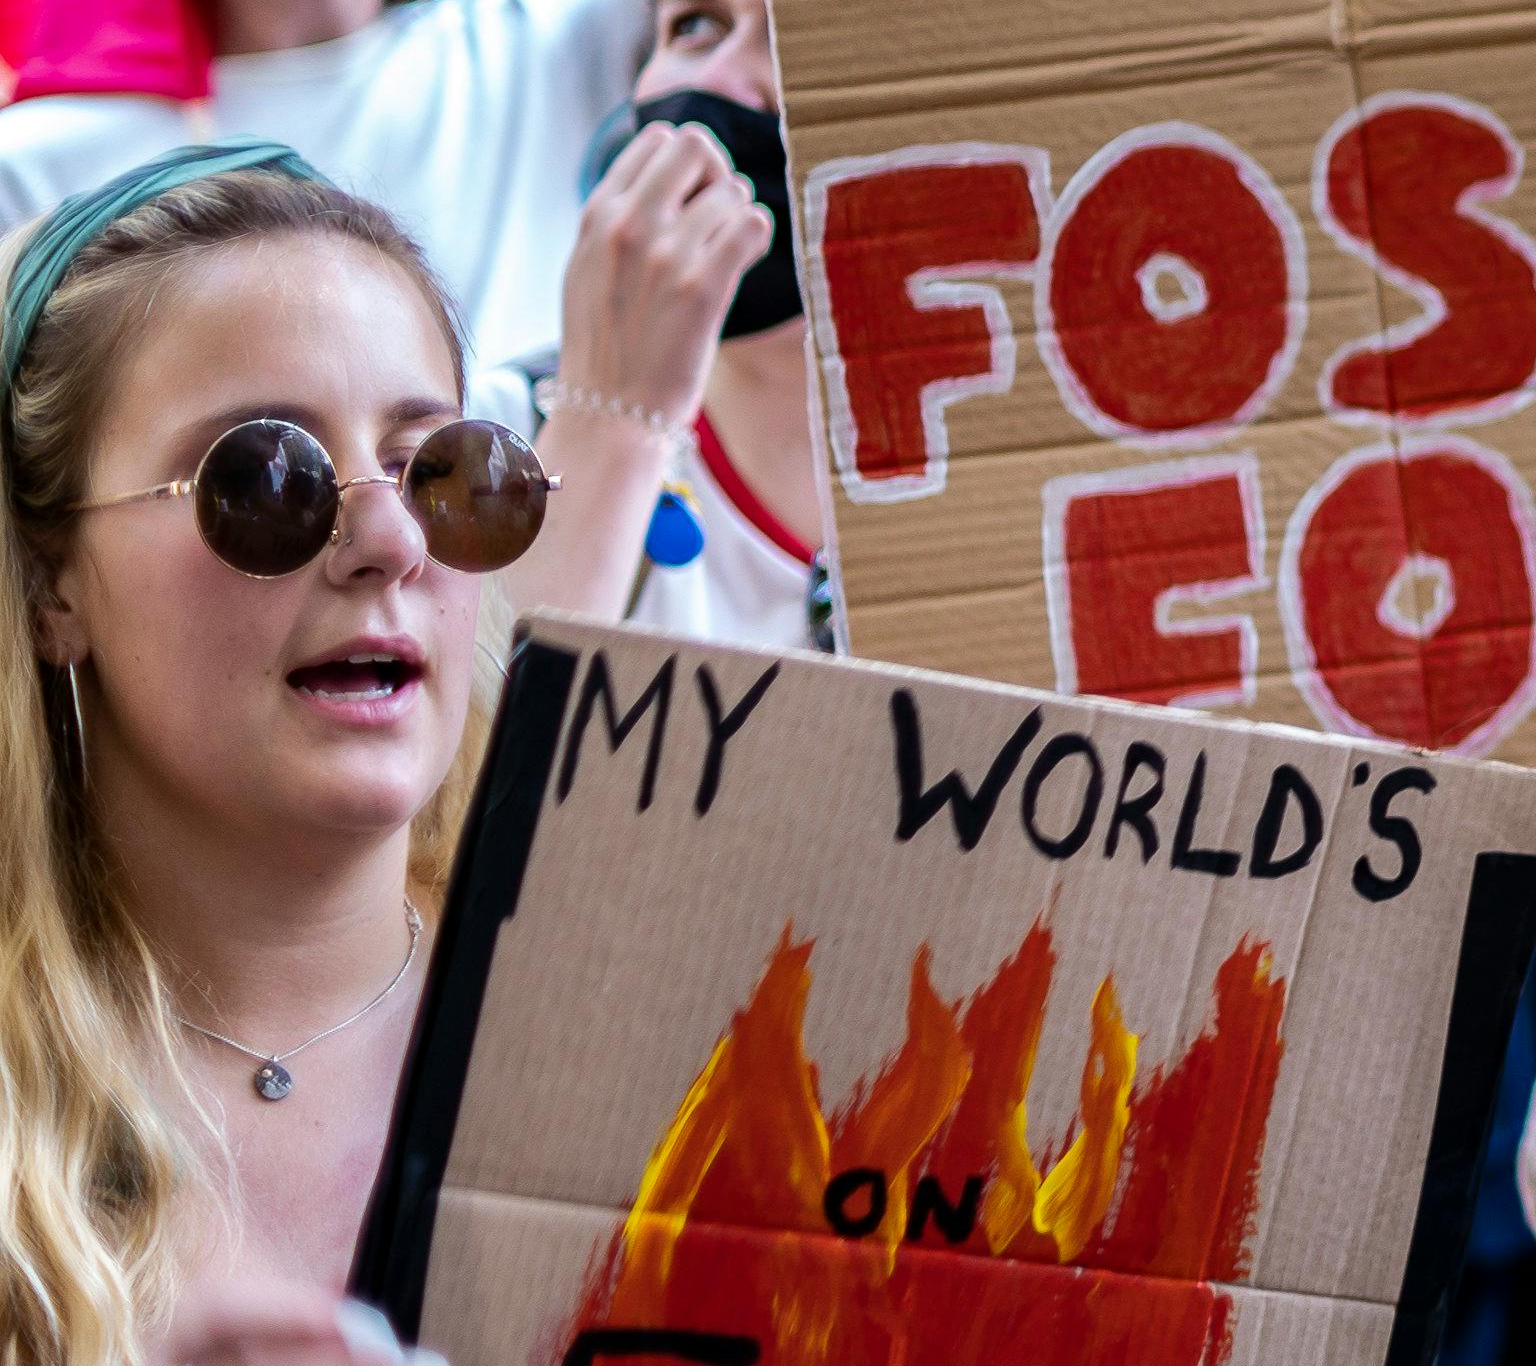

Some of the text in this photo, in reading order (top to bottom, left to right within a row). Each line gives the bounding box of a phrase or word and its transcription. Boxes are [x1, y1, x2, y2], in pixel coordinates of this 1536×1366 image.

[554, 649, 1437, 904] MY WORLD'S
[822, 1167, 985, 1239] ON
